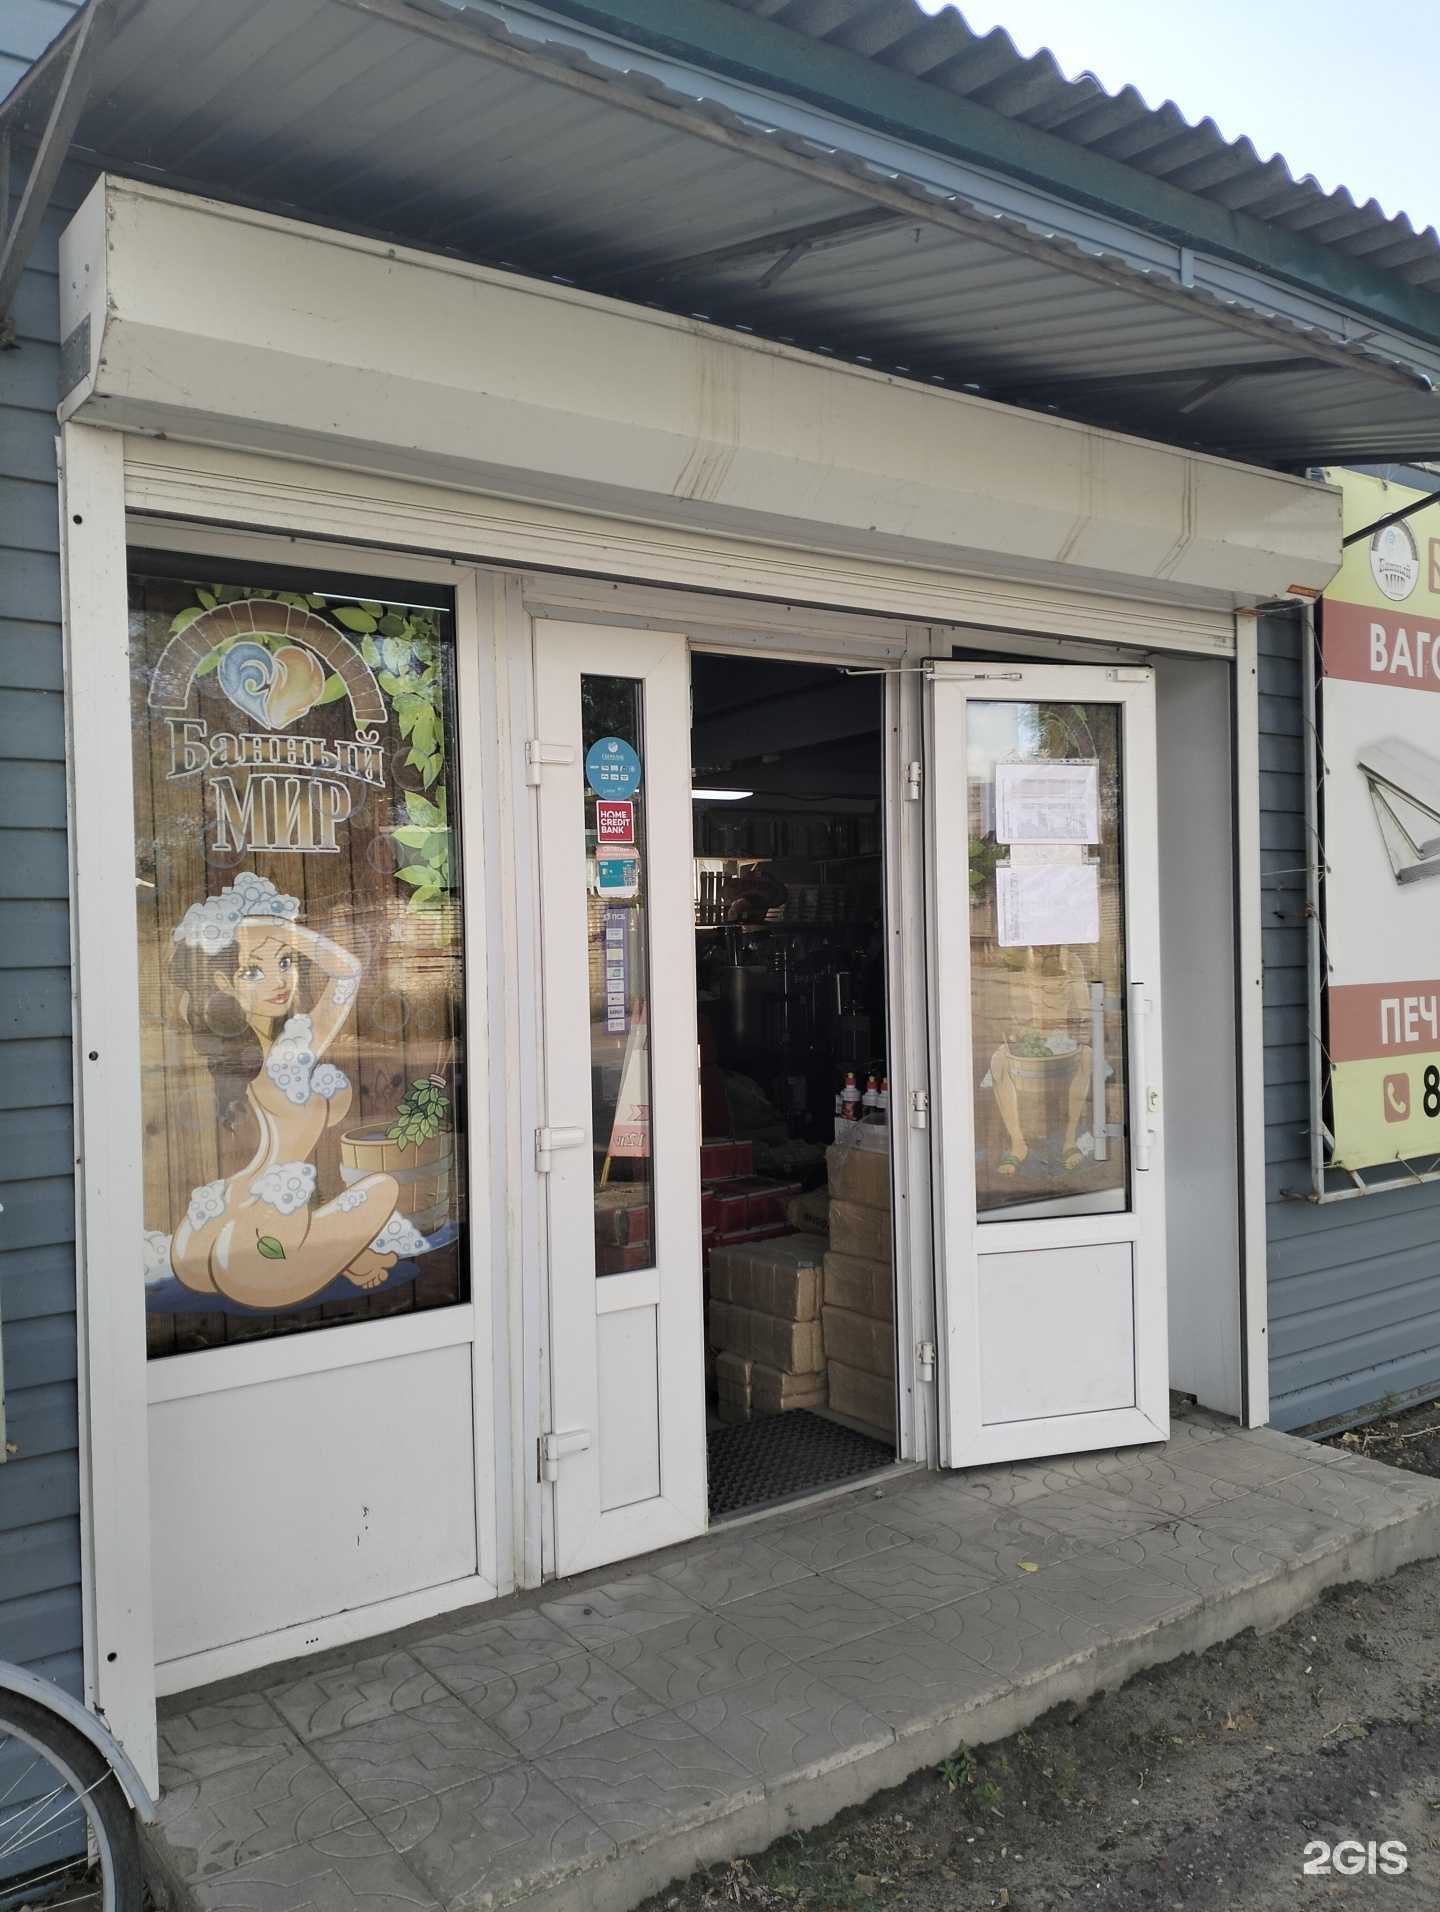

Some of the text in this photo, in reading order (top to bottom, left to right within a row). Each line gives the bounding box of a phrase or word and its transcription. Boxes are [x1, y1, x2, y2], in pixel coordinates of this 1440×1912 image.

[164, 717, 386, 788] Банный
[210, 773, 352, 853] МИР
[600, 810, 628, 818] HOME
[600, 818, 630, 826] CREDIT
[601, 826, 624, 834] BANK
[1380, 995, 1438, 1044] ПЕЧ
[1423, 1065, 1440, 1118] 8
